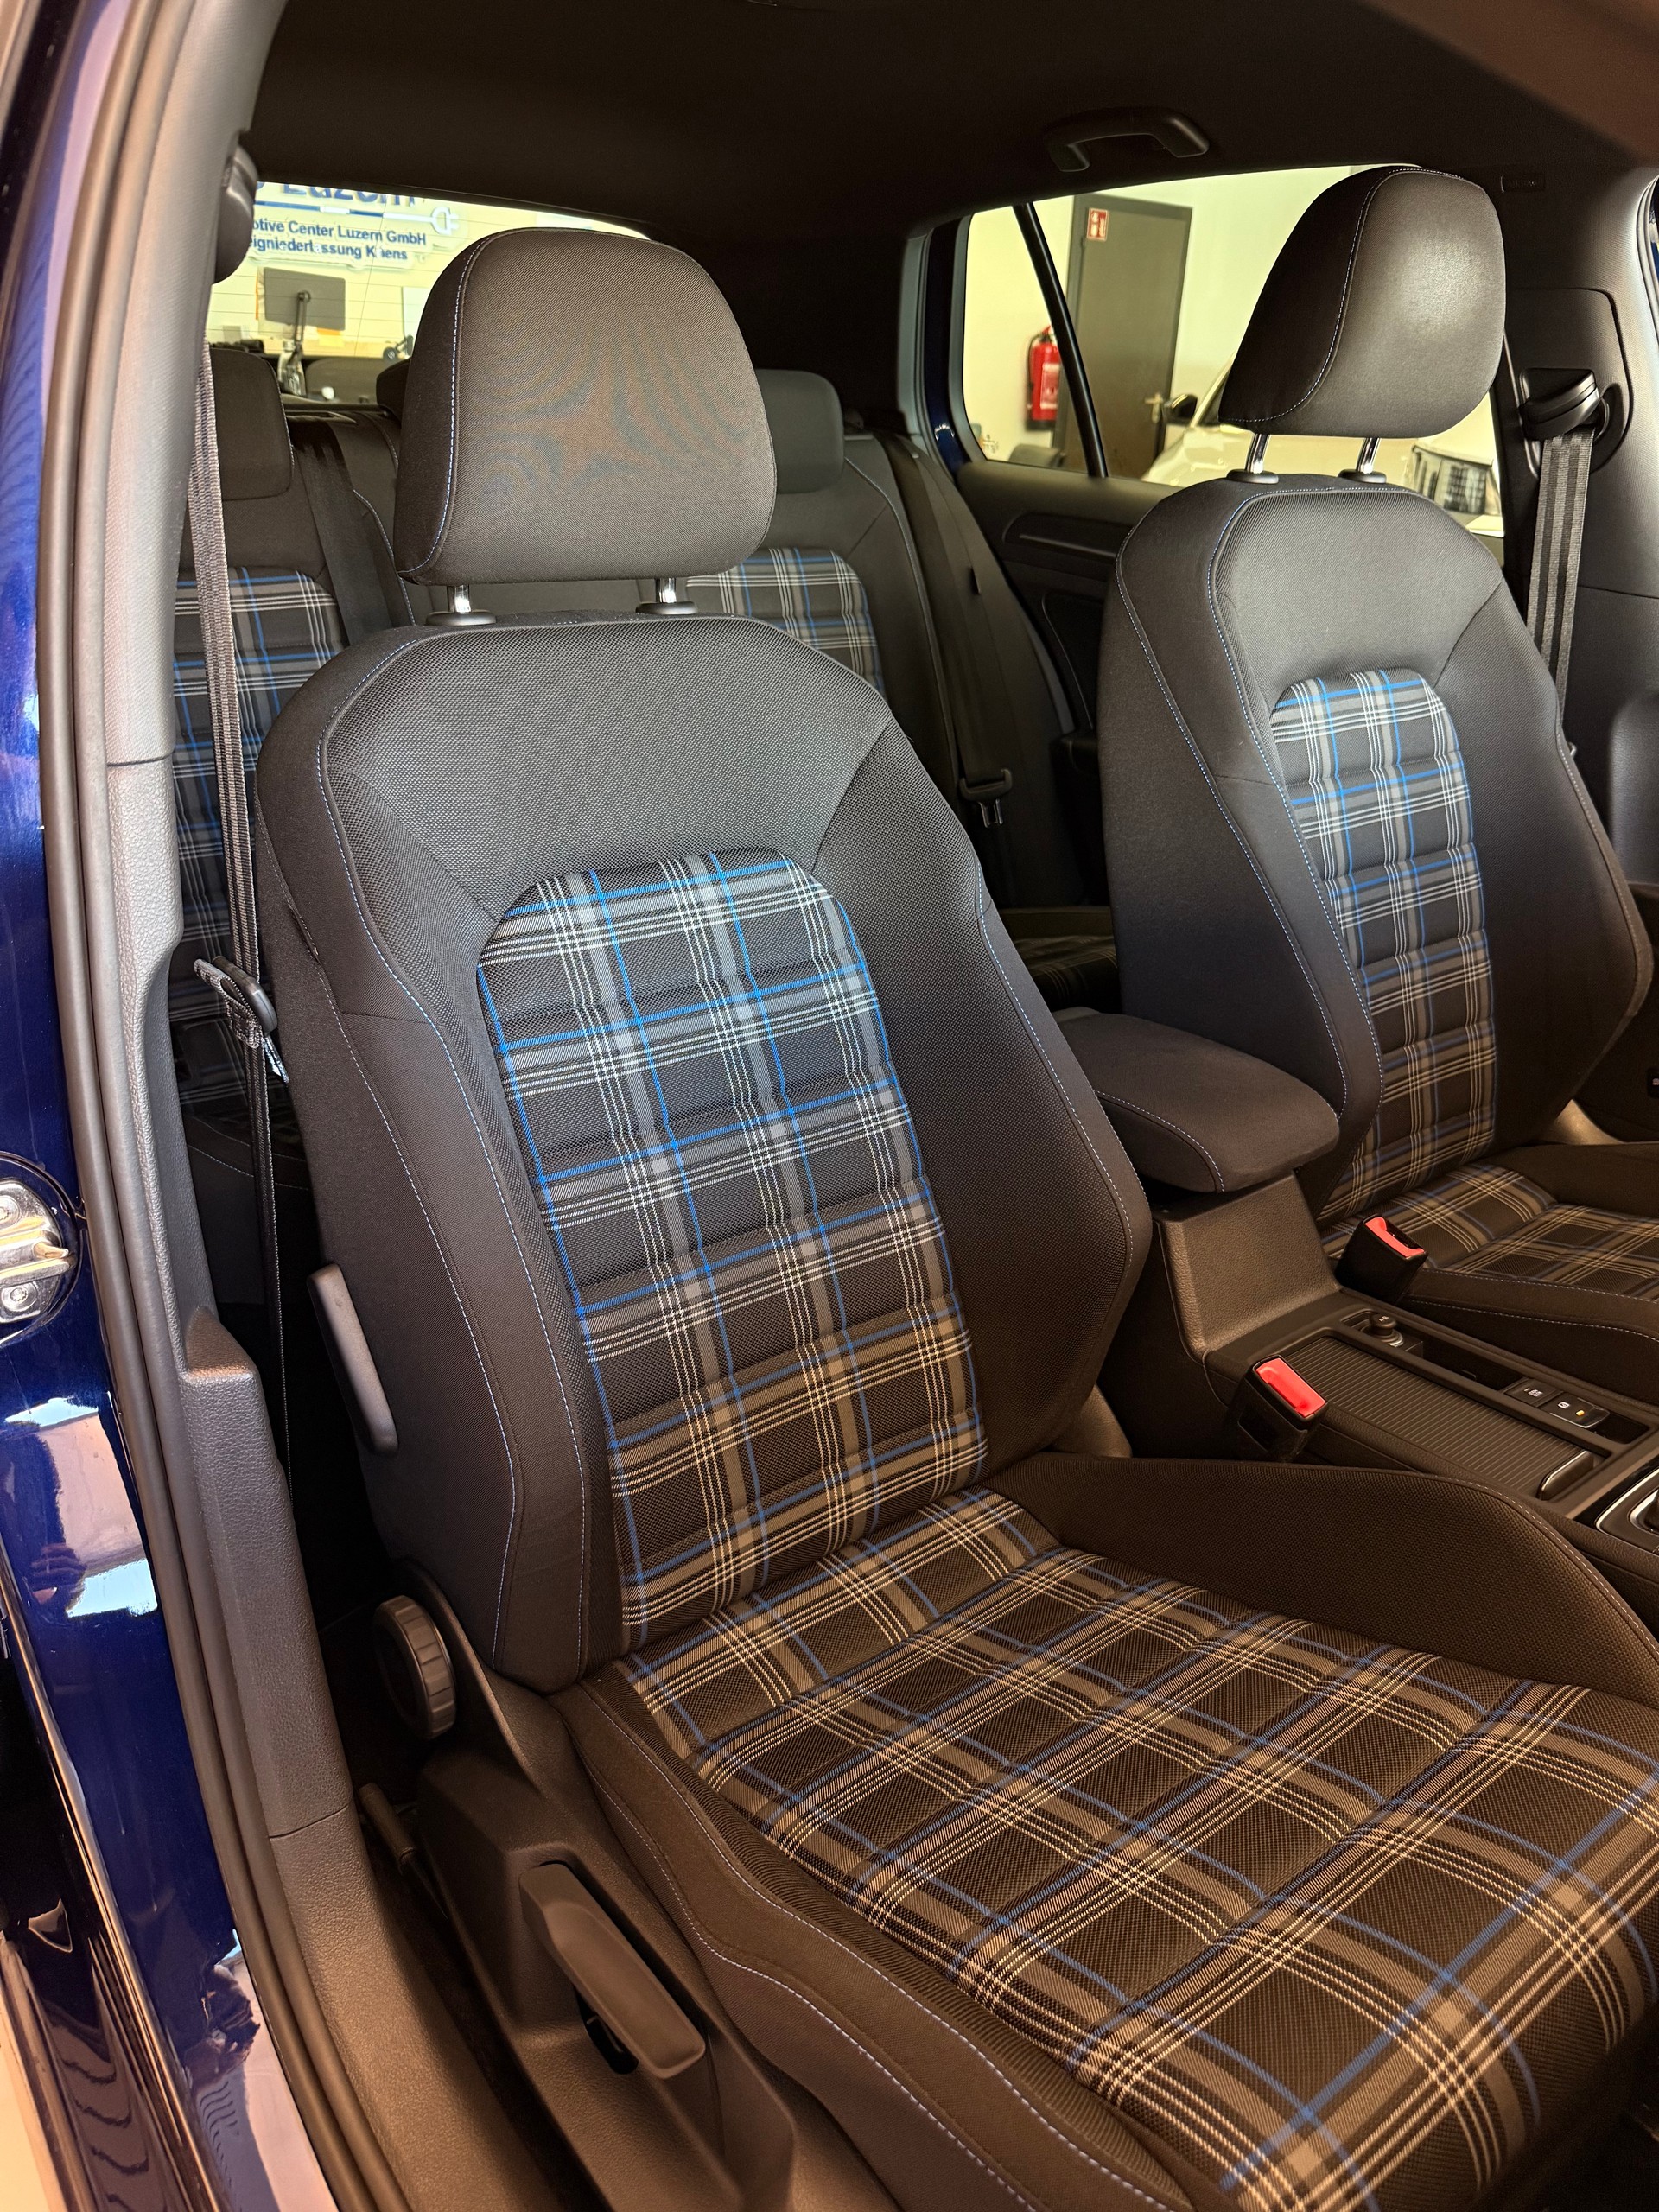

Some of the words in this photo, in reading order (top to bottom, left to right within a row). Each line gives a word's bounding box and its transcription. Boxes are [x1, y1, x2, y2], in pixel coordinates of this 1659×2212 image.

[288, 220, 334, 237] Center
[338, 225, 383, 241] Luzern
[386, 230, 426, 245] GmbH
